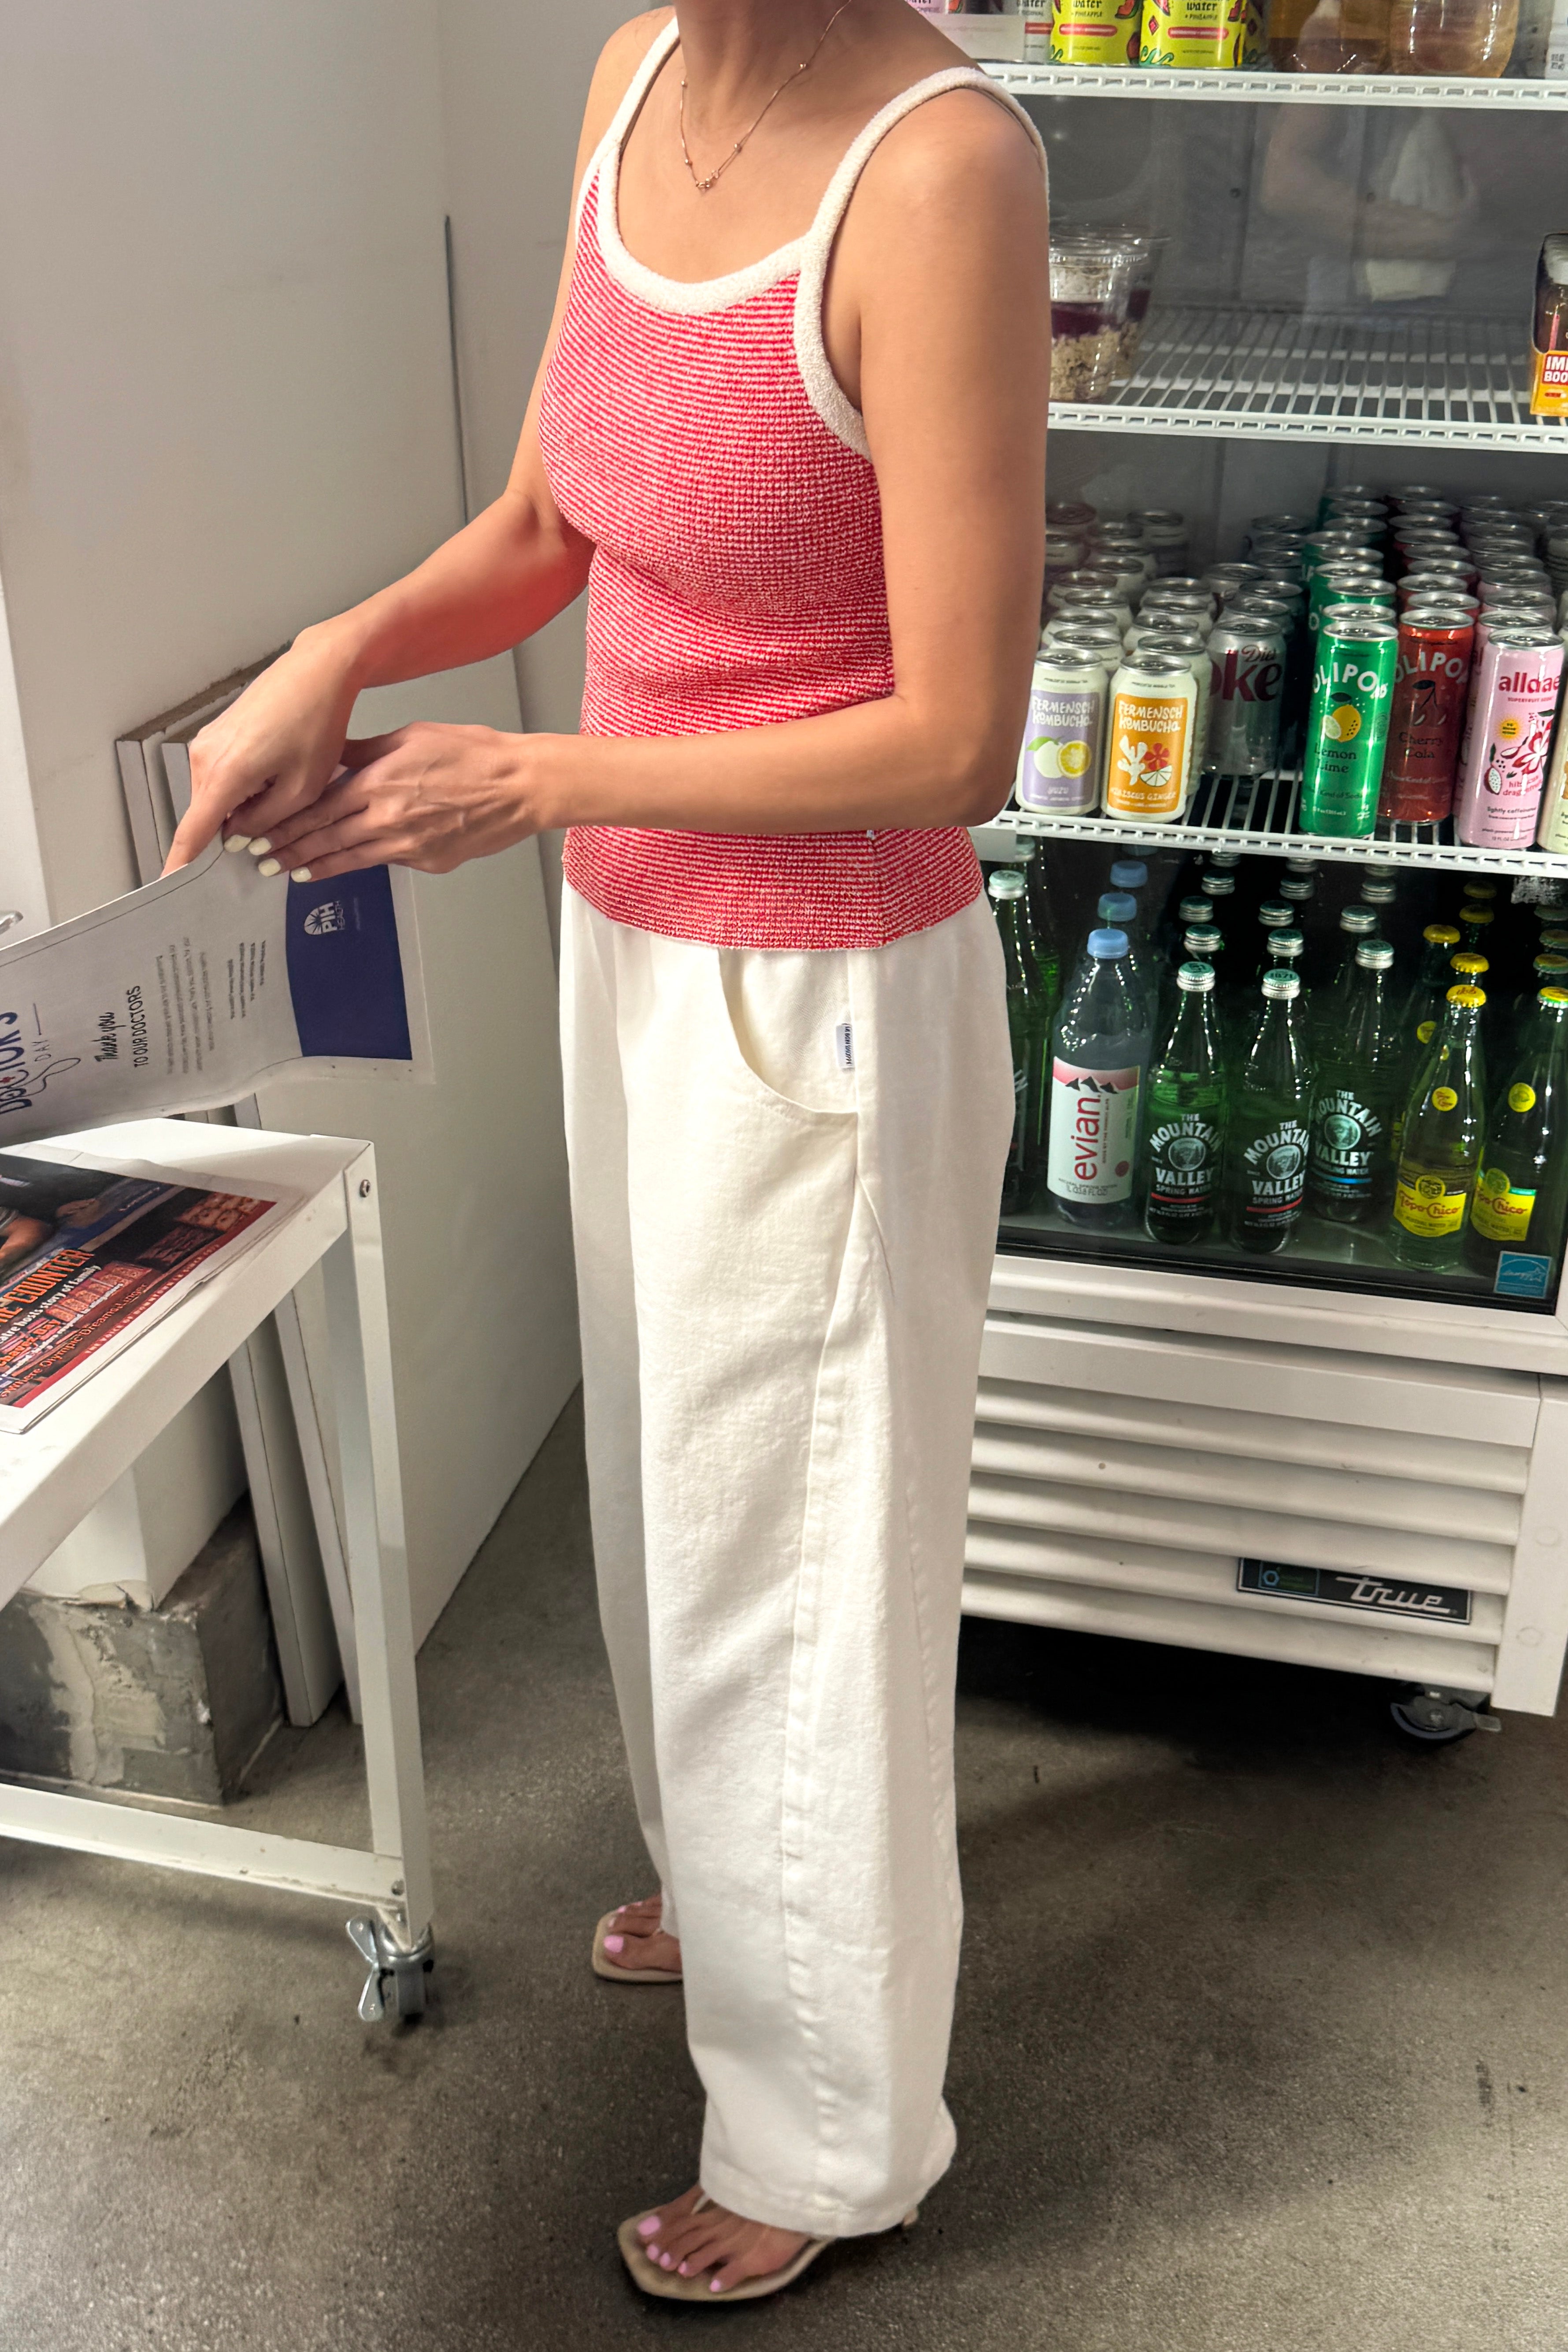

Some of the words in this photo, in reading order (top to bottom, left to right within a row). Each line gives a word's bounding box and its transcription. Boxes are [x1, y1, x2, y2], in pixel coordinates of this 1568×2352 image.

[1186, 2, 1217, 11] water
[1544, 371, 1568, 383] BOO
[1030, 695, 1095, 715] FERMENSCH
[1119, 700, 1185, 720] FERMENSCH
[1315, 742, 1357, 760] Lemon
[319, 902, 338, 933] PIH
[127, 985, 148, 1037] DOCTORS
[98, 1012, 127, 1032] you
[31, 1039, 52, 1062] DAY
[90, 1033, 119, 1062] Thank
[133, 1037, 148, 1056] OUR
[133, 1056, 149, 1068] TO
[1336, 1089, 1354, 1101] THE
[1279, 1120, 1297, 1130] THE
[1155, 1167, 1214, 1186] VALLEY
[1252, 1169, 1306, 1196] VALLEY
[1398, 1190, 1427, 1212] Topo
[1426, 1202, 1461, 1219] Chico
[1492, 1197, 1528, 1215] Chico
[3, 1249, 95, 1304] COUNTER
[40, 1292, 67, 1310] story
[62, 1280, 74, 1293] of
[0, 1306, 23, 1324] HE
[40, 1336, 83, 1368] Olympic
[80, 1303, 120, 1336] Dreams
[1335, 1577, 1451, 1614] true
